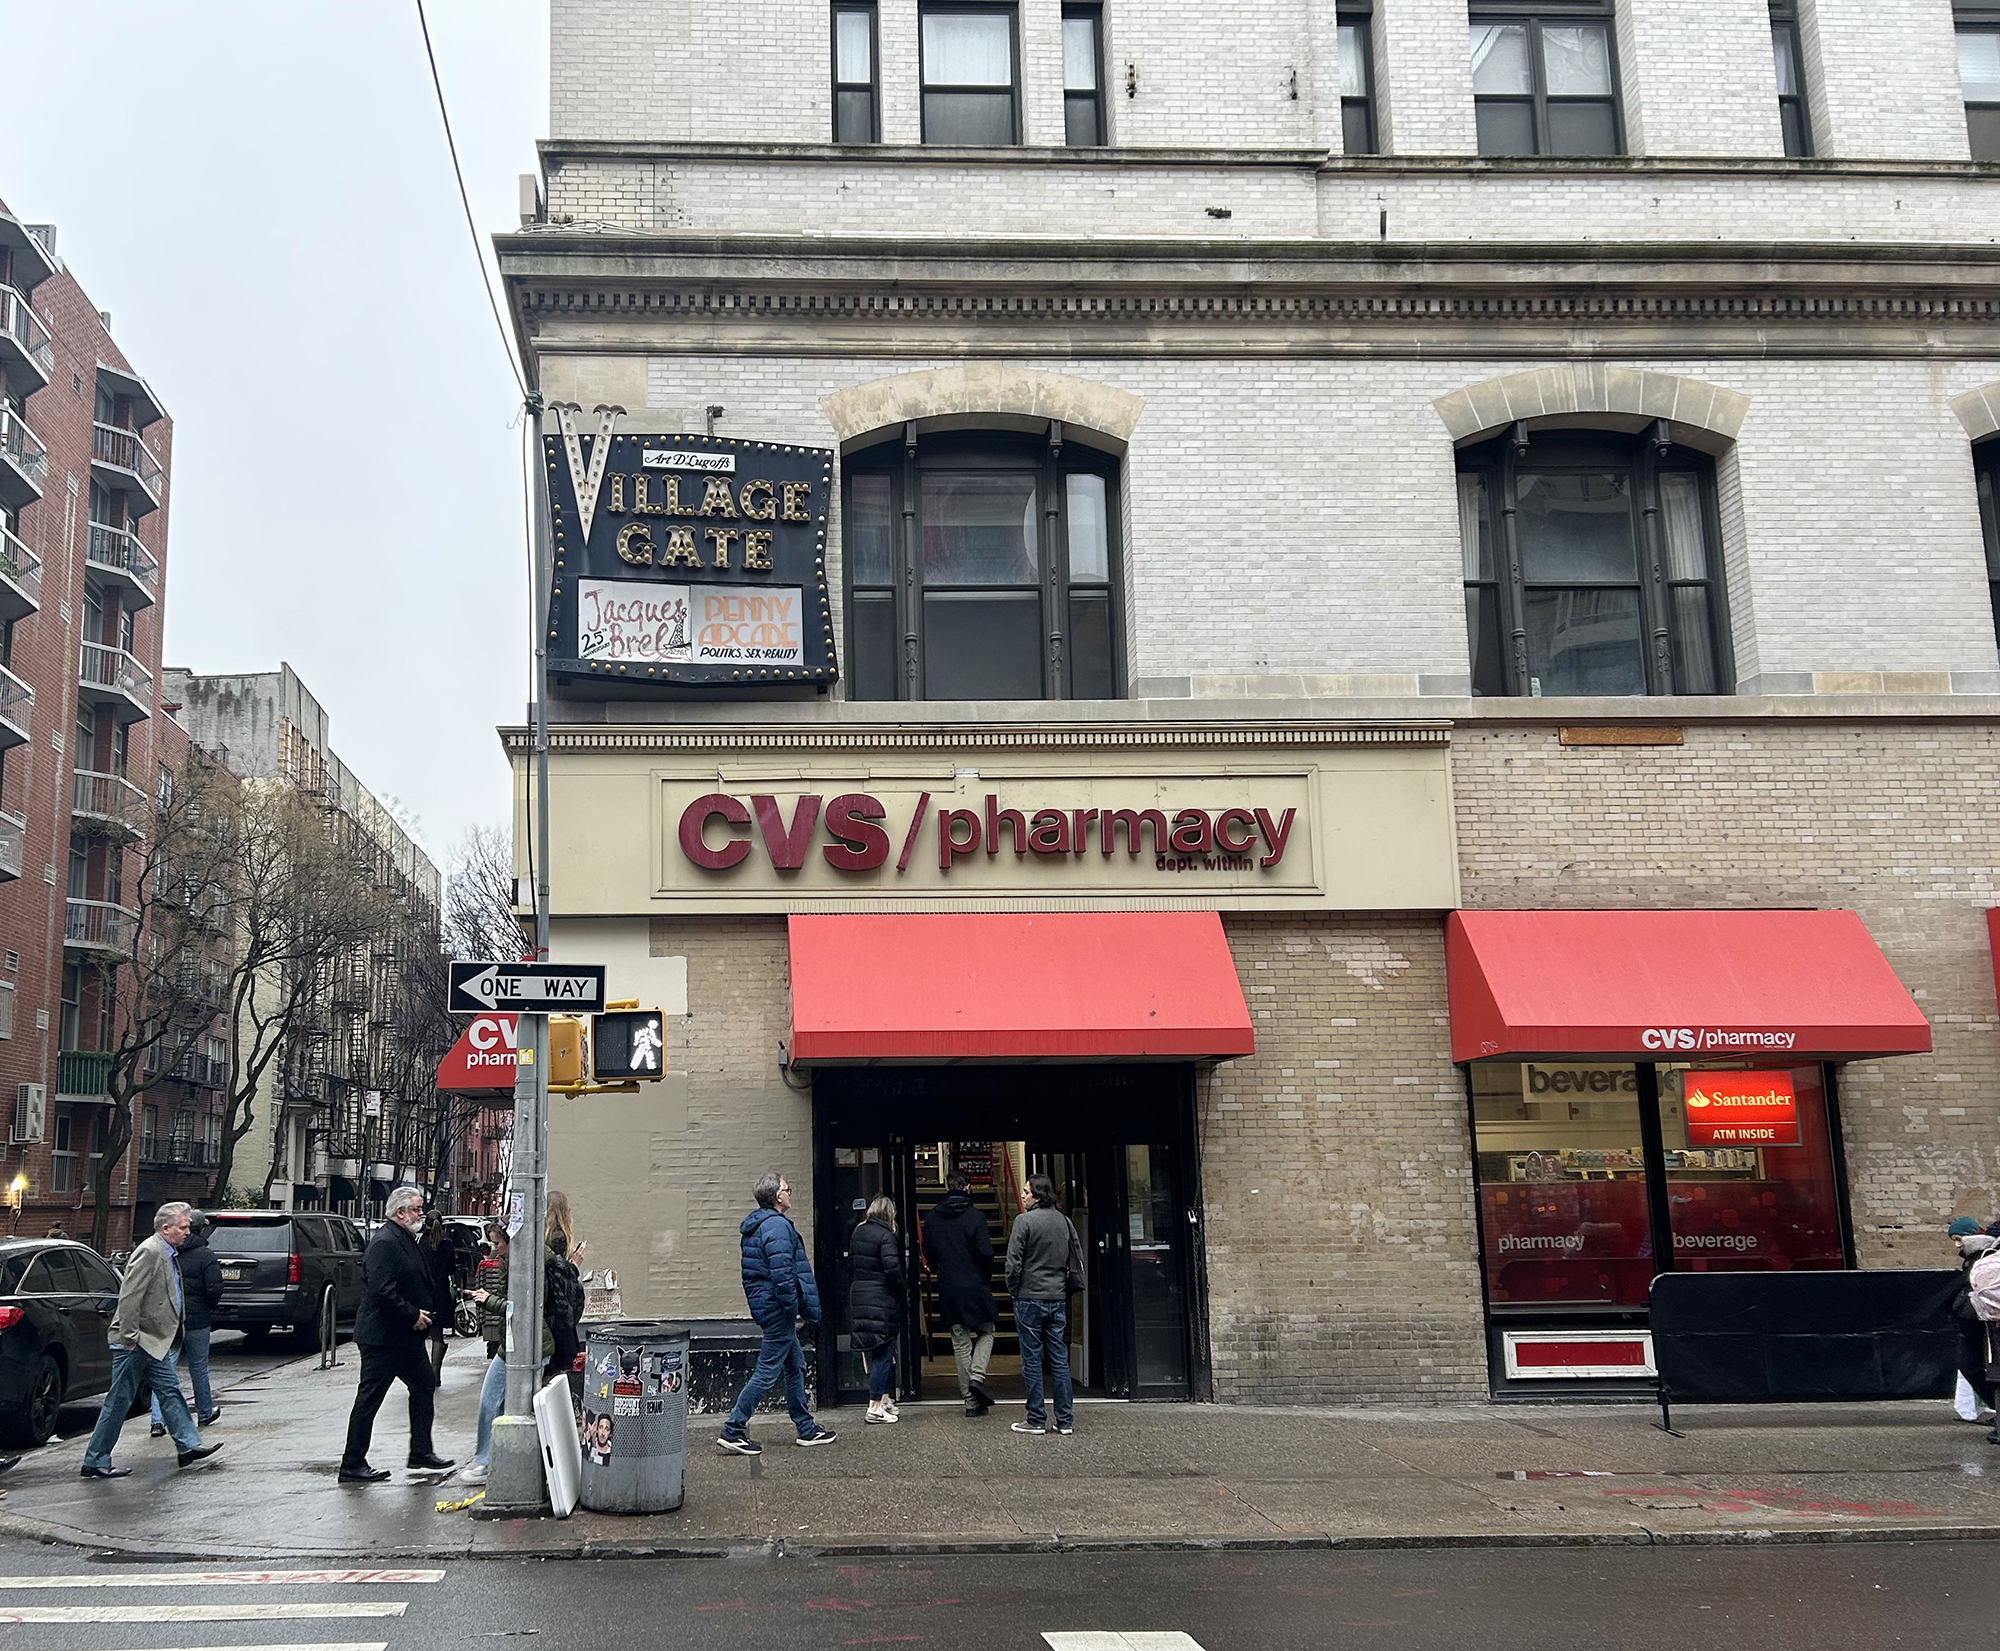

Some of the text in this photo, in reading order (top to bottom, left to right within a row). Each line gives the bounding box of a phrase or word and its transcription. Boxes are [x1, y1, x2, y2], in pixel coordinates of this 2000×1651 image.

[645, 453, 671, 464] Art
[548, 400, 812, 547] VILLAGE
[616, 522, 774, 569] GATE
[584, 588, 683, 633] Jacques
[704, 595, 793, 622] PENNY
[608, 622, 685, 659] Brel
[698, 622, 798, 648] ARCADE
[744, 648, 761, 659] SEX
[764, 648, 798, 661] REALITY
[678, 791, 1297, 871] CVS/pharmacy
[1156, 855, 1254, 873] dept. within
[480, 978, 589, 998] ONE WAY
[468, 1018, 519, 1050] CV
[1641, 1028, 1796, 1049] CVS/pharmacy
[1713, 1090, 1792, 1106] Santander
[1713, 1129, 1775, 1139] ATM INSIDE
[1498, 1232, 1758, 1253] pharmacy beverage
